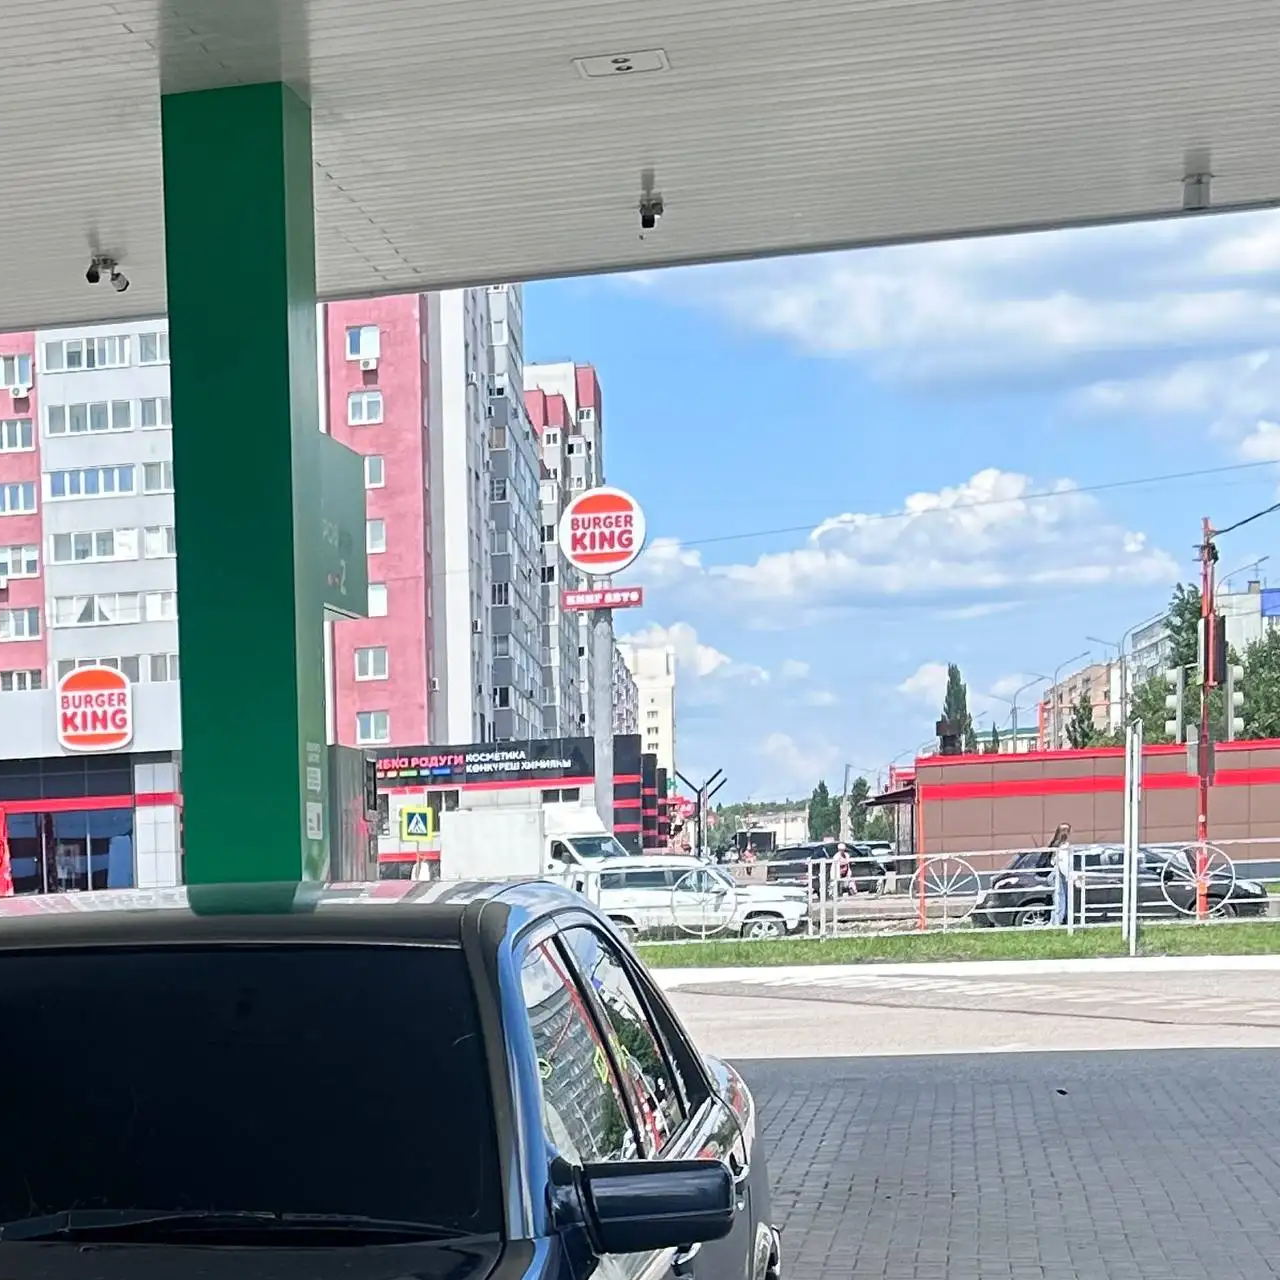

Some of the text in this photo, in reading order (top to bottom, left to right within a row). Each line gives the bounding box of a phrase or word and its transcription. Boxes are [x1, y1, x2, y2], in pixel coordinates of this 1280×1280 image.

[570, 514, 634, 531] BURGER
[570, 529, 634, 552] KING
[61, 692, 128, 709] BURGER
[61, 708, 128, 732] KING
[465, 750, 526, 762] КОСМЕТИКА
